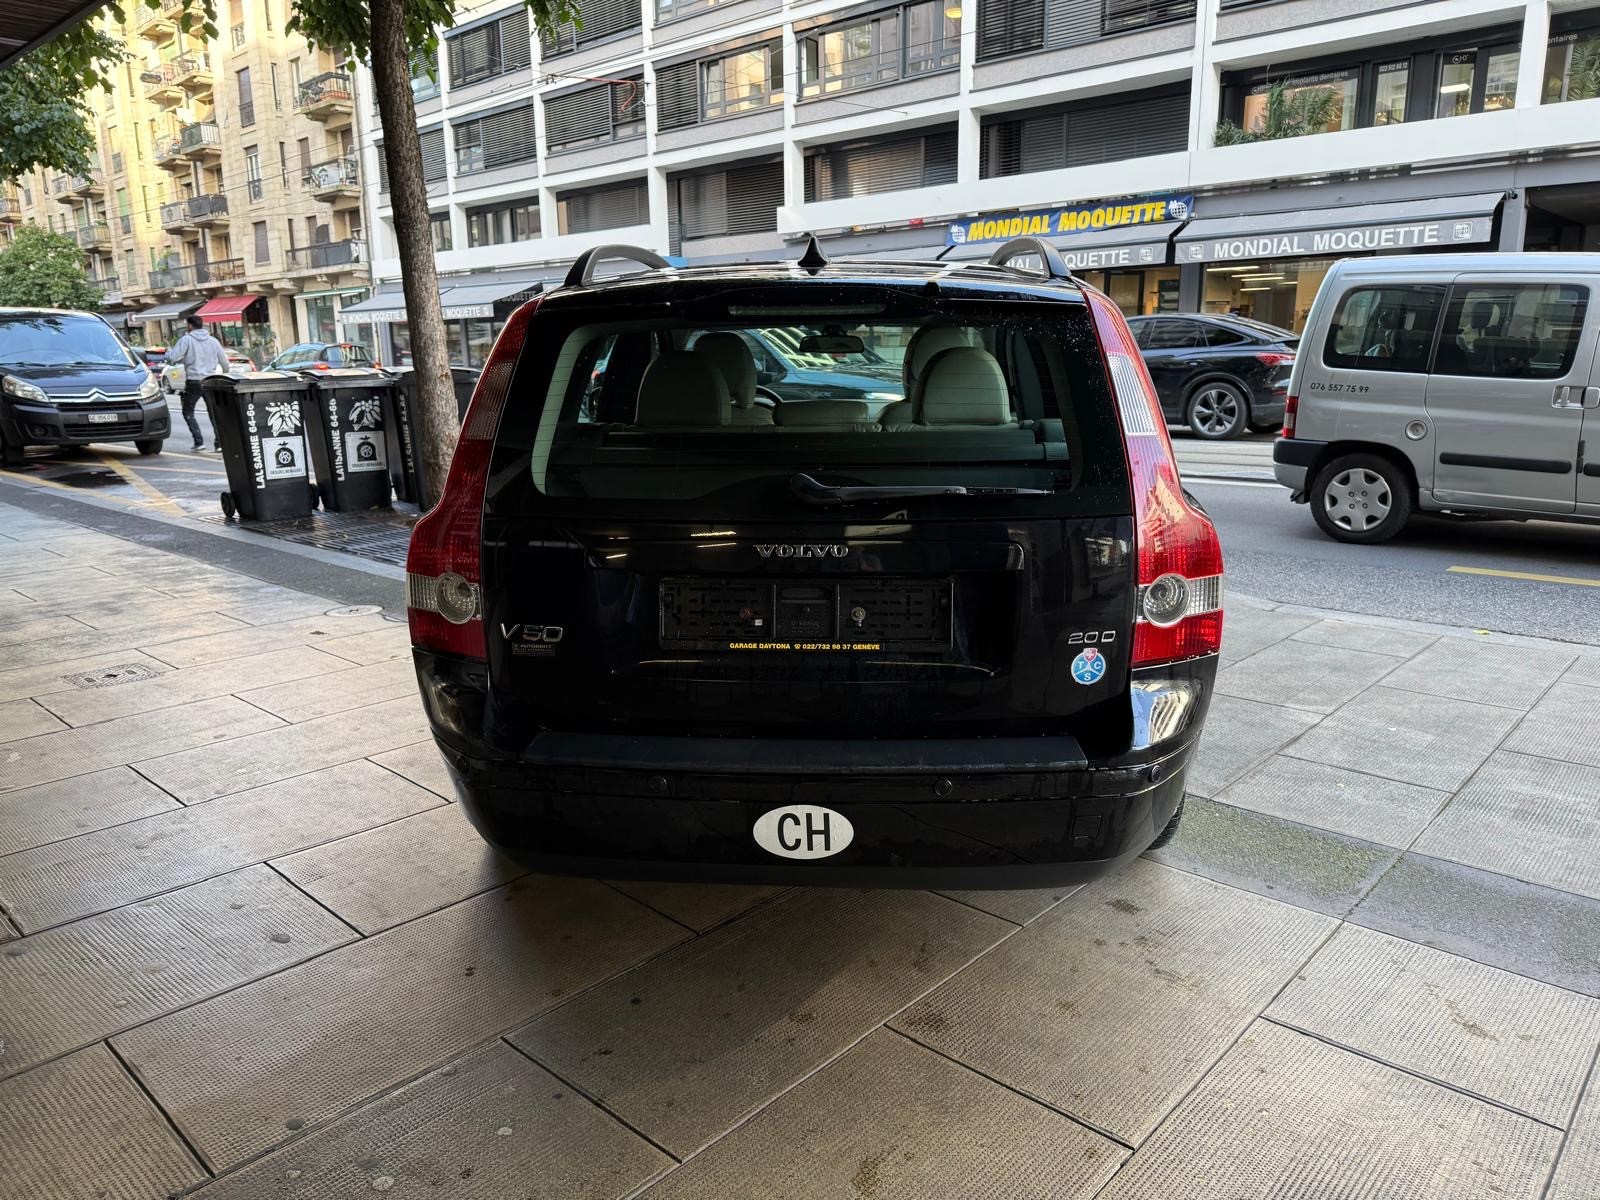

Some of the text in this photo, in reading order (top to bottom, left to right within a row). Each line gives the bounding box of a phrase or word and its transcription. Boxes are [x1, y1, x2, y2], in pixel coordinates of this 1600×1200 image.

[1547, 33, 1578, 45] entaires
[1319, 70, 1349, 81] dentaires
[967, 200, 1167, 242] MONDIAL MOQUETTE
[1214, 224, 1440, 260] MONDIAL MOQUETTE
[1041, 248, 1130, 271] QUETTE
[446, 306, 481, 318] MOQUETTE
[1310, 382, 1370, 393] 076 557 75 99
[753, 543, 849, 559] VOLVO
[729, 642, 758, 650] GARAGE
[758, 642, 791, 650] DAYTONA
[802, 643, 831, 651] 022/732
[842, 643, 851, 651] 37
[777, 812, 831, 852] CH
